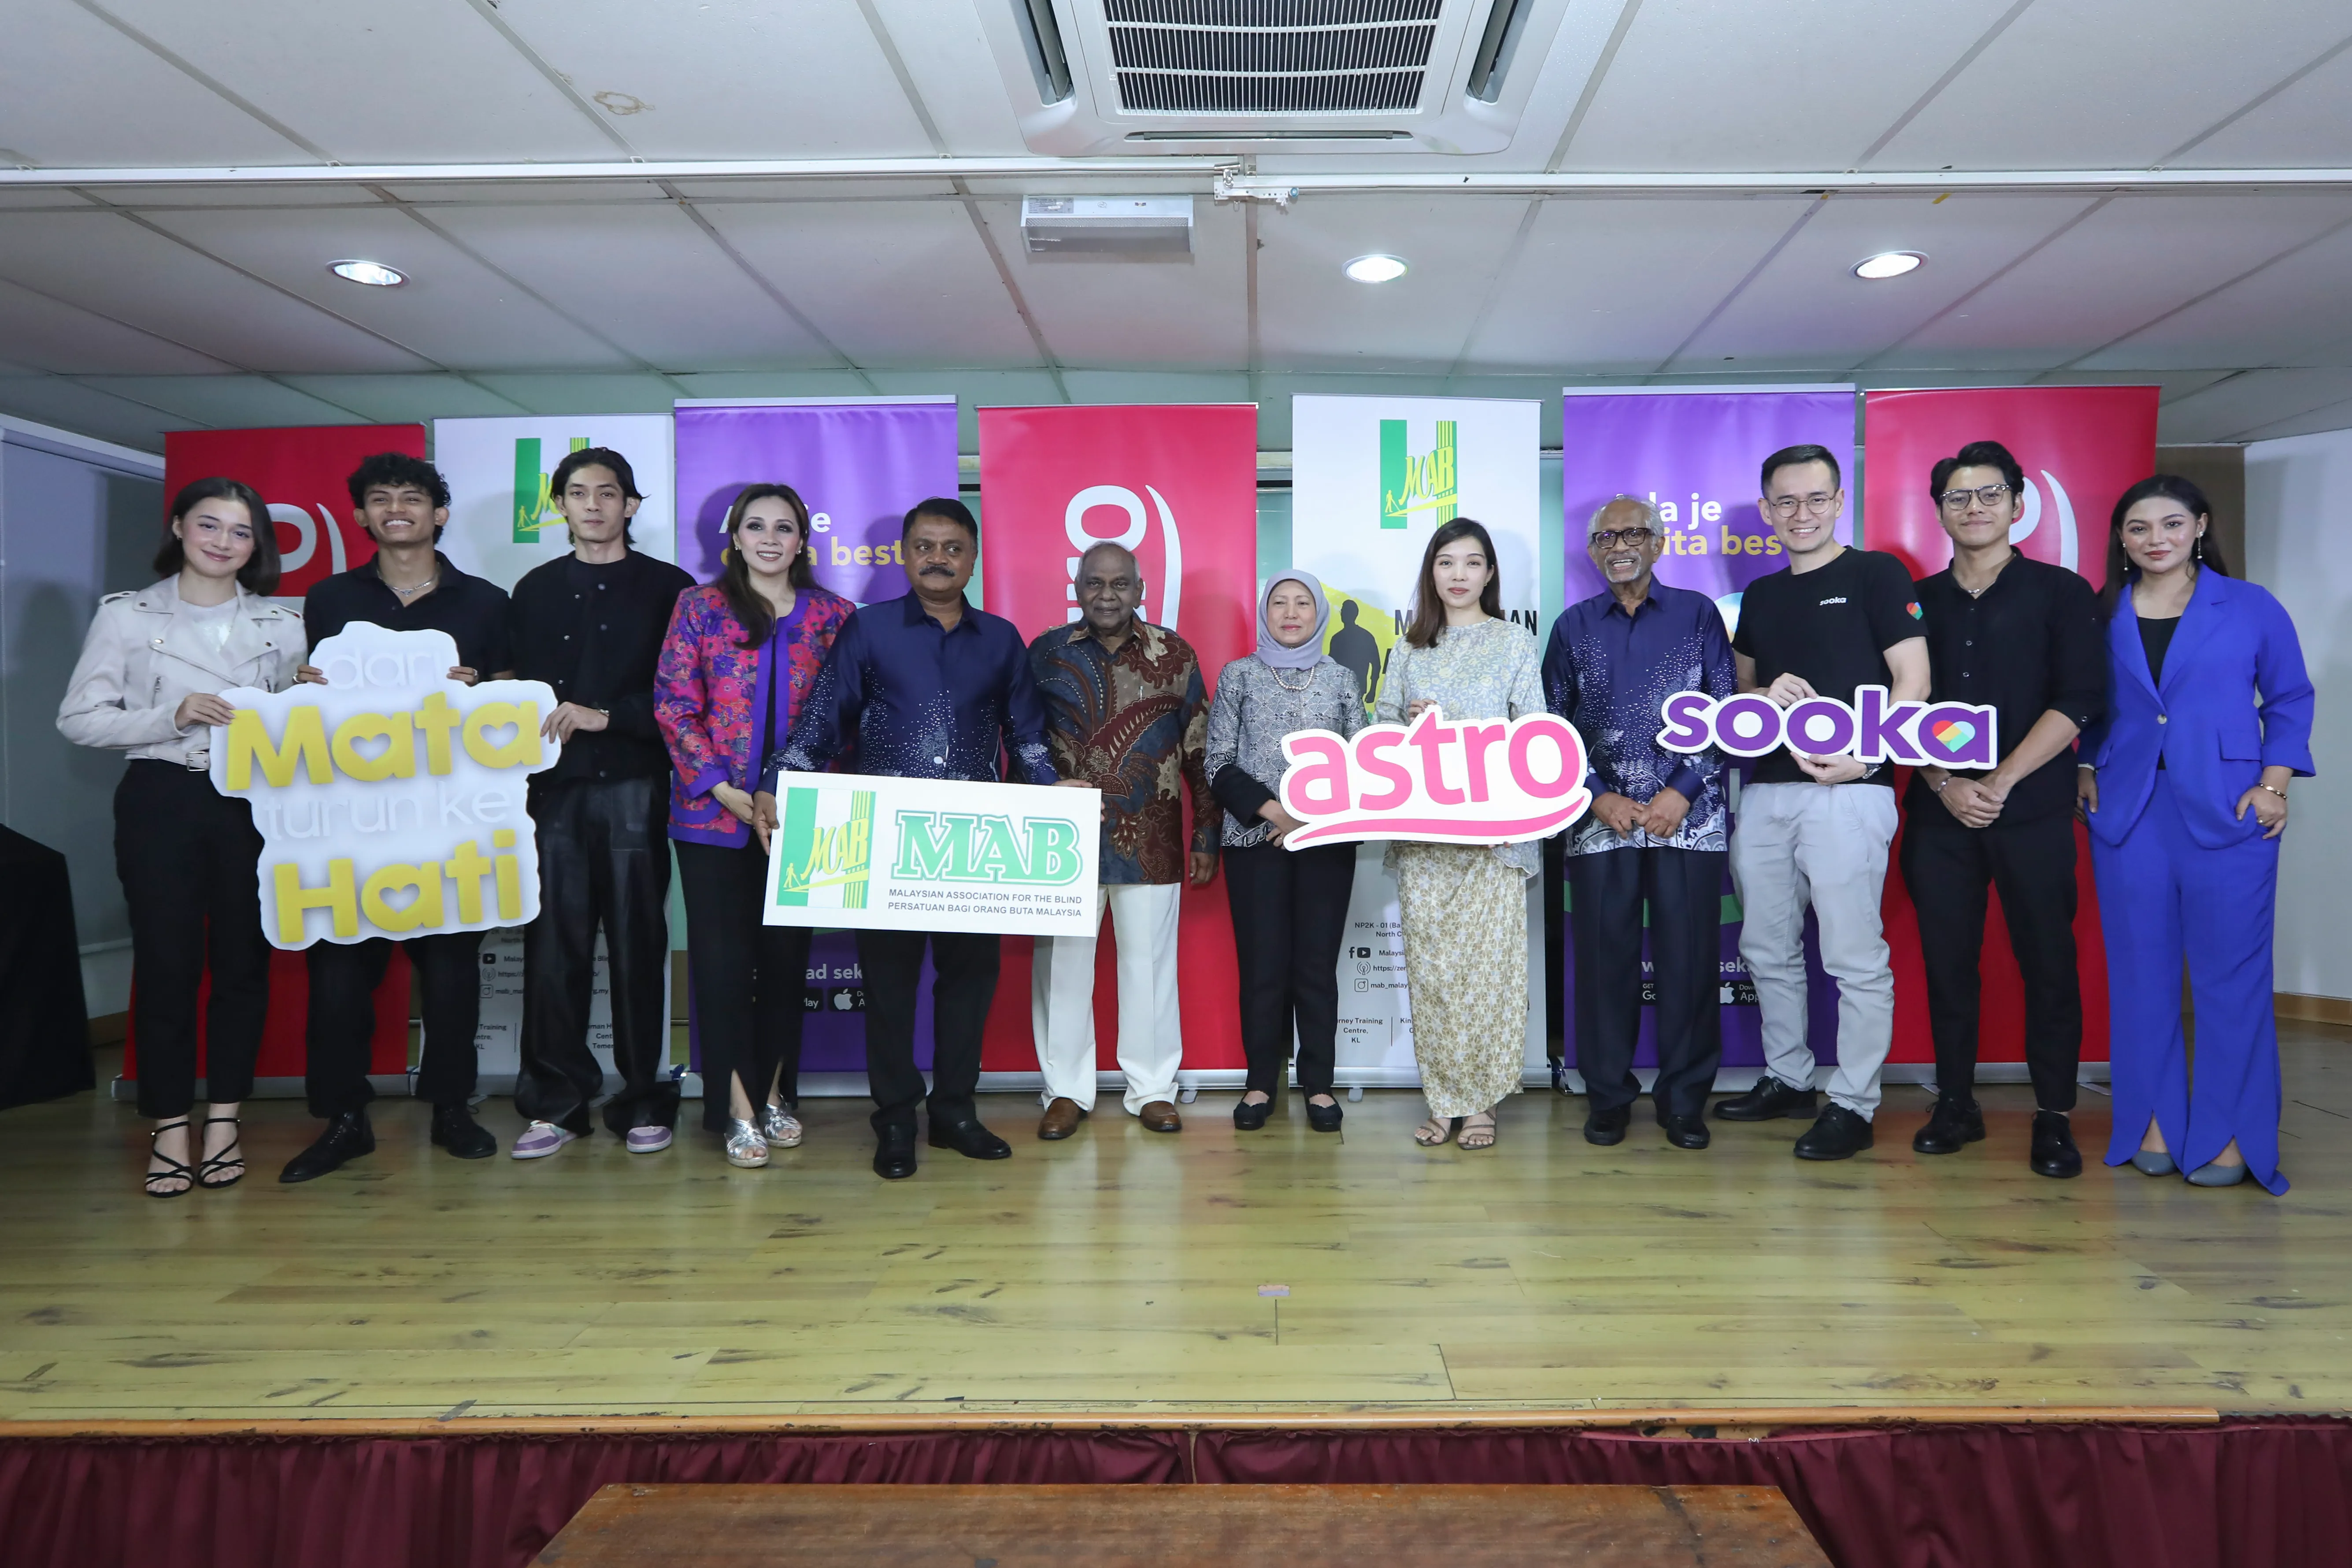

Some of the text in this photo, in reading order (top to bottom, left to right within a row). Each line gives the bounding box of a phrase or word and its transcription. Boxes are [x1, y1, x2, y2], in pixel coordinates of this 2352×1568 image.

[1398, 445, 1454, 506] MAB
[1688, 492, 1722, 530] je
[831, 536, 904, 566] best
[1722, 525, 1782, 555] bes
[1819, 597, 1847, 606] sooka
[326, 646, 441, 690] dari
[226, 691, 543, 791] Mata
[1663, 690, 1989, 763] sooka
[1288, 712, 1580, 815] astro
[263, 781, 512, 841] turun ke
[800, 817, 868, 880] MAB
[891, 809, 1083, 886] MAB
[274, 829, 522, 943] Hati
[888, 902, 945, 912] PERSATUAN
[973, 905, 1007, 914] ORANG
[1036, 908, 1082, 917] MALAYSIA
[889, 889, 944, 898] MALAYSIAN
[946, 891, 1010, 901] ASSOCIATION
[1055, 896, 1082, 904] BLIND
[804, 997, 819, 1009] lay
